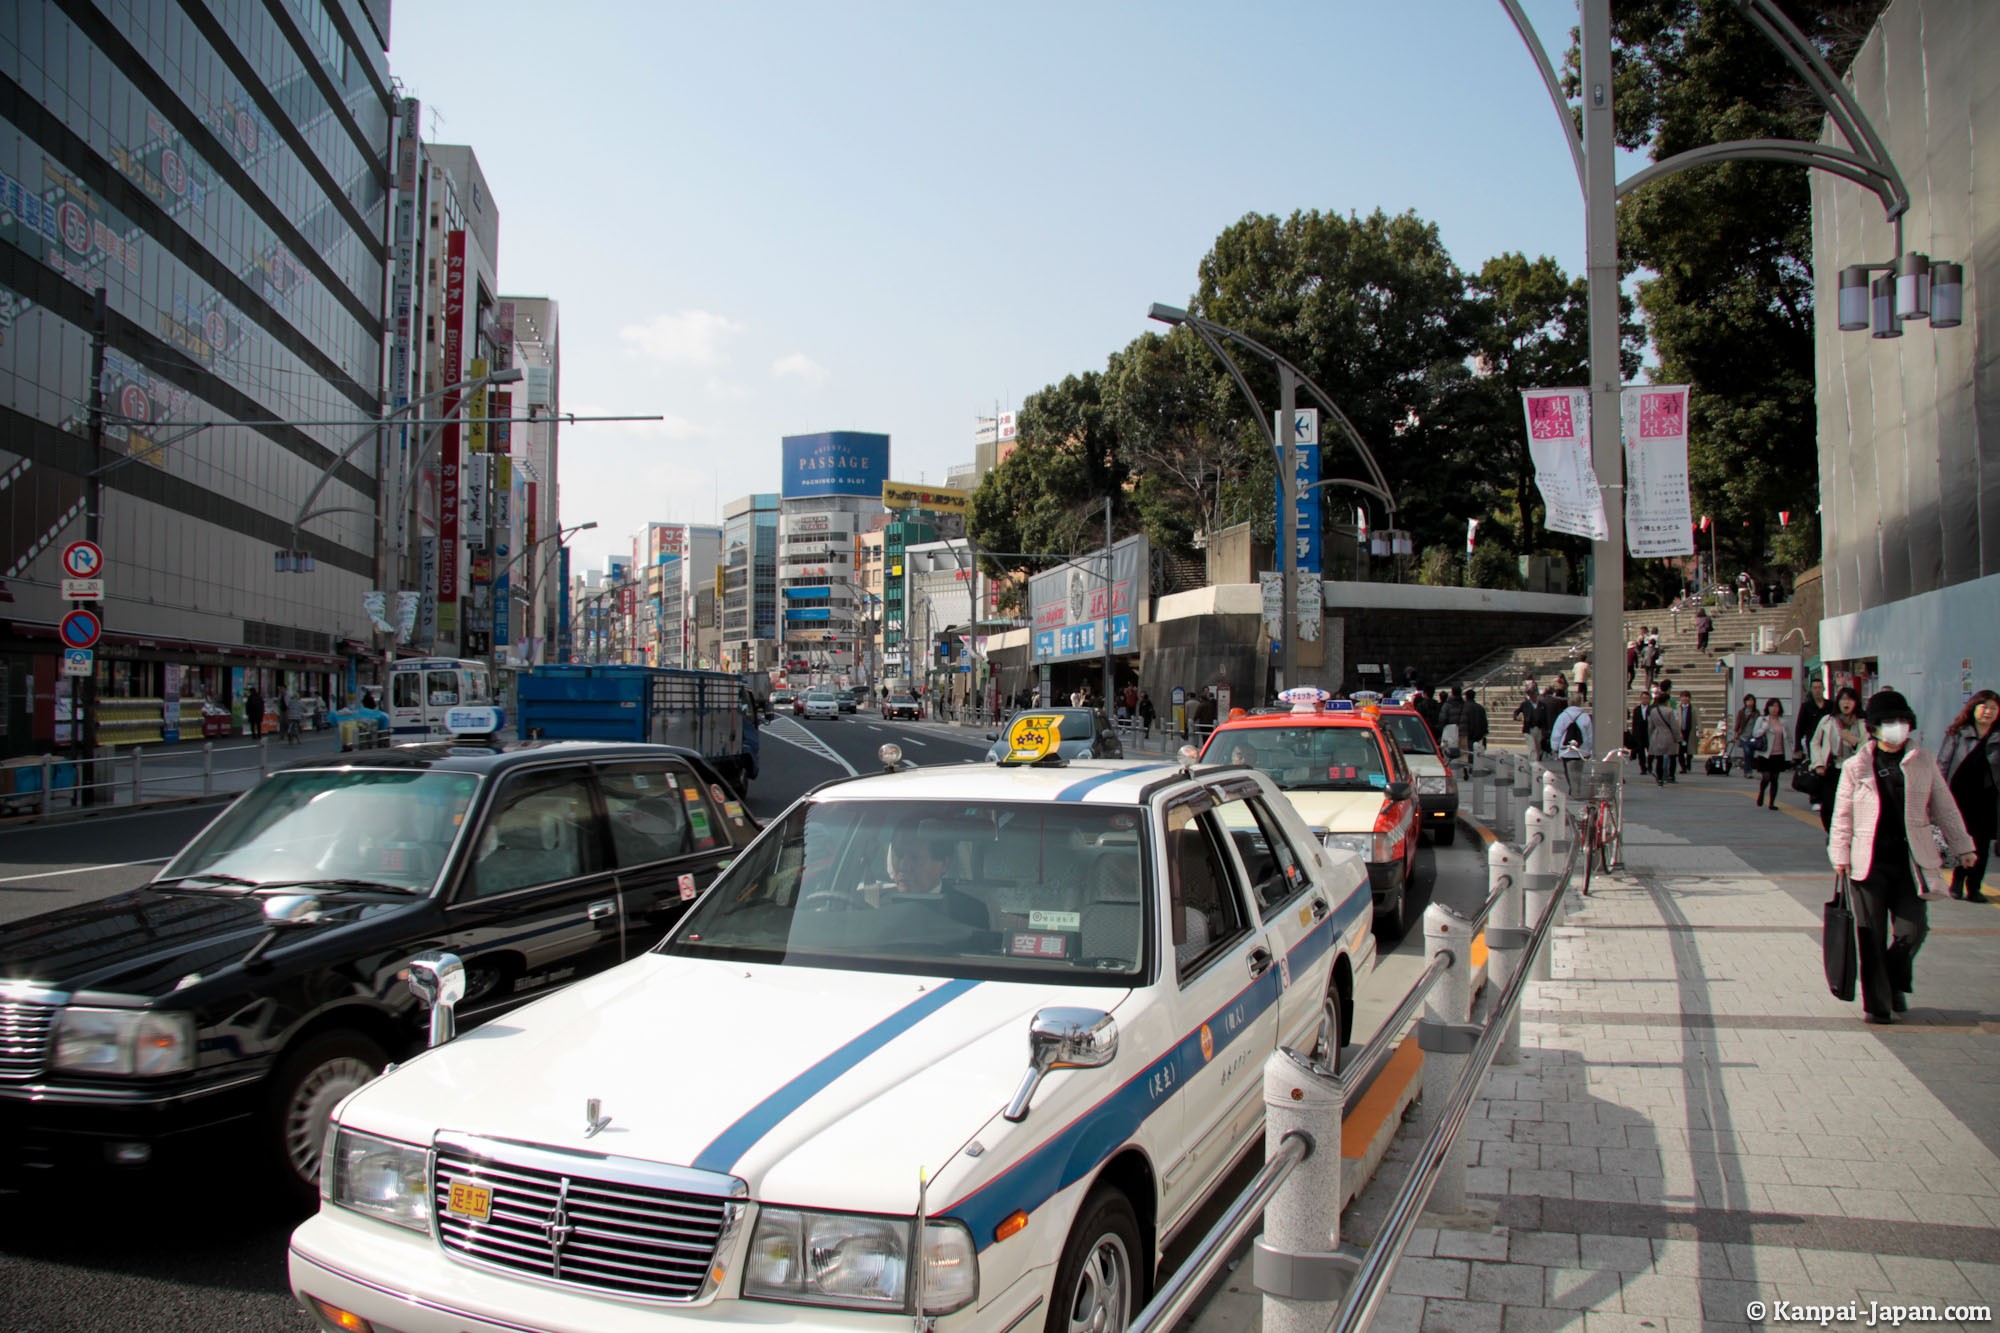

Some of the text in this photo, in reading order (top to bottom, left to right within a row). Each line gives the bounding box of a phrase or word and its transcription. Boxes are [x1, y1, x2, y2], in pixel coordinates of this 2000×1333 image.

[448, 256, 463, 315] カラオケ
[799, 456, 869, 470] PASSAGE
[801, 478, 835, 486] PACHINKO
[442, 463, 457, 525] カラオケ
[495, 586, 508, 637] 新生銀行
[961, 650, 969, 659] P
[1026, 719, 1042, 728] 個人
[1013, 935, 1062, 955] 空車
